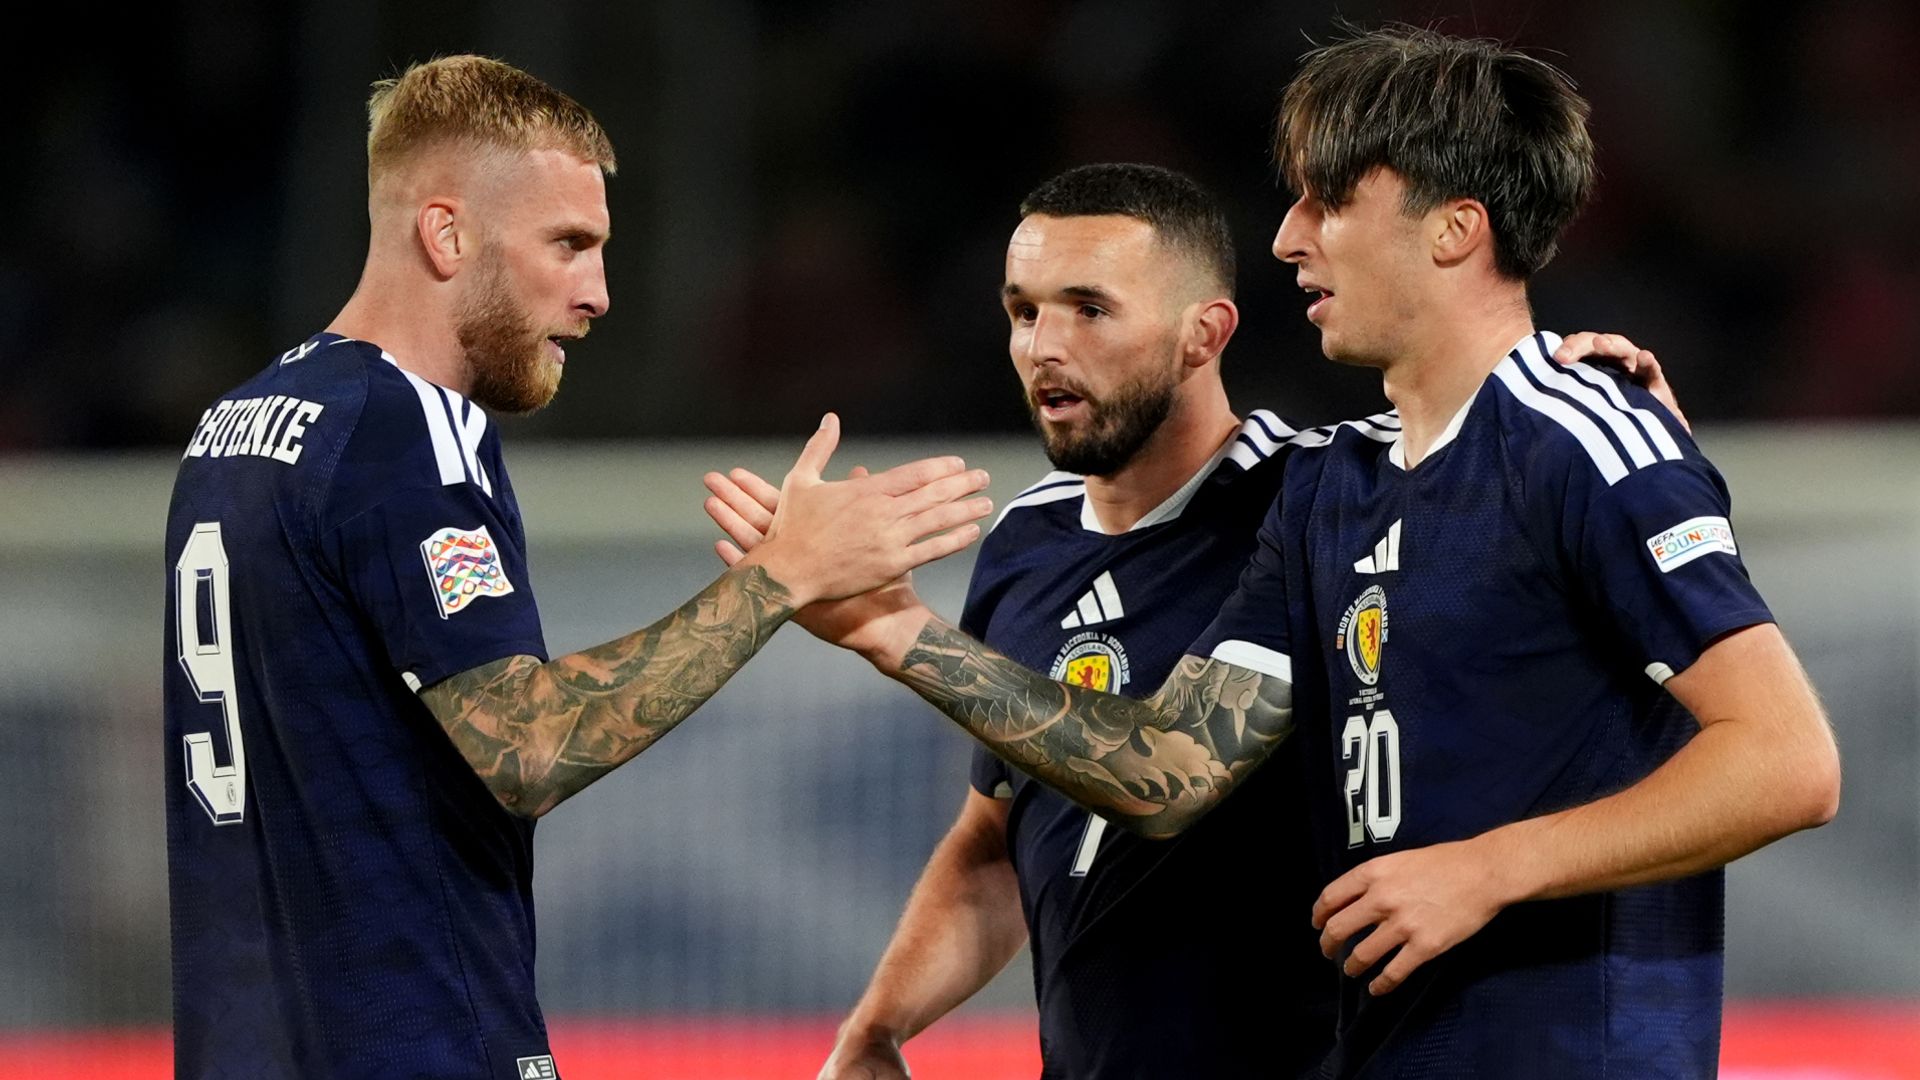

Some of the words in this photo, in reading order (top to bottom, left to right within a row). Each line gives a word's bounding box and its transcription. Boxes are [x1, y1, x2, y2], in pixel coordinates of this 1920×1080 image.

[1651, 532, 1675, 548] UEFA
[176, 522, 246, 825] 9
[1049, 654, 1064, 680] ORTH
[1107, 636, 1130, 671] SCOTLAND
[1341, 709, 1401, 850] 20
